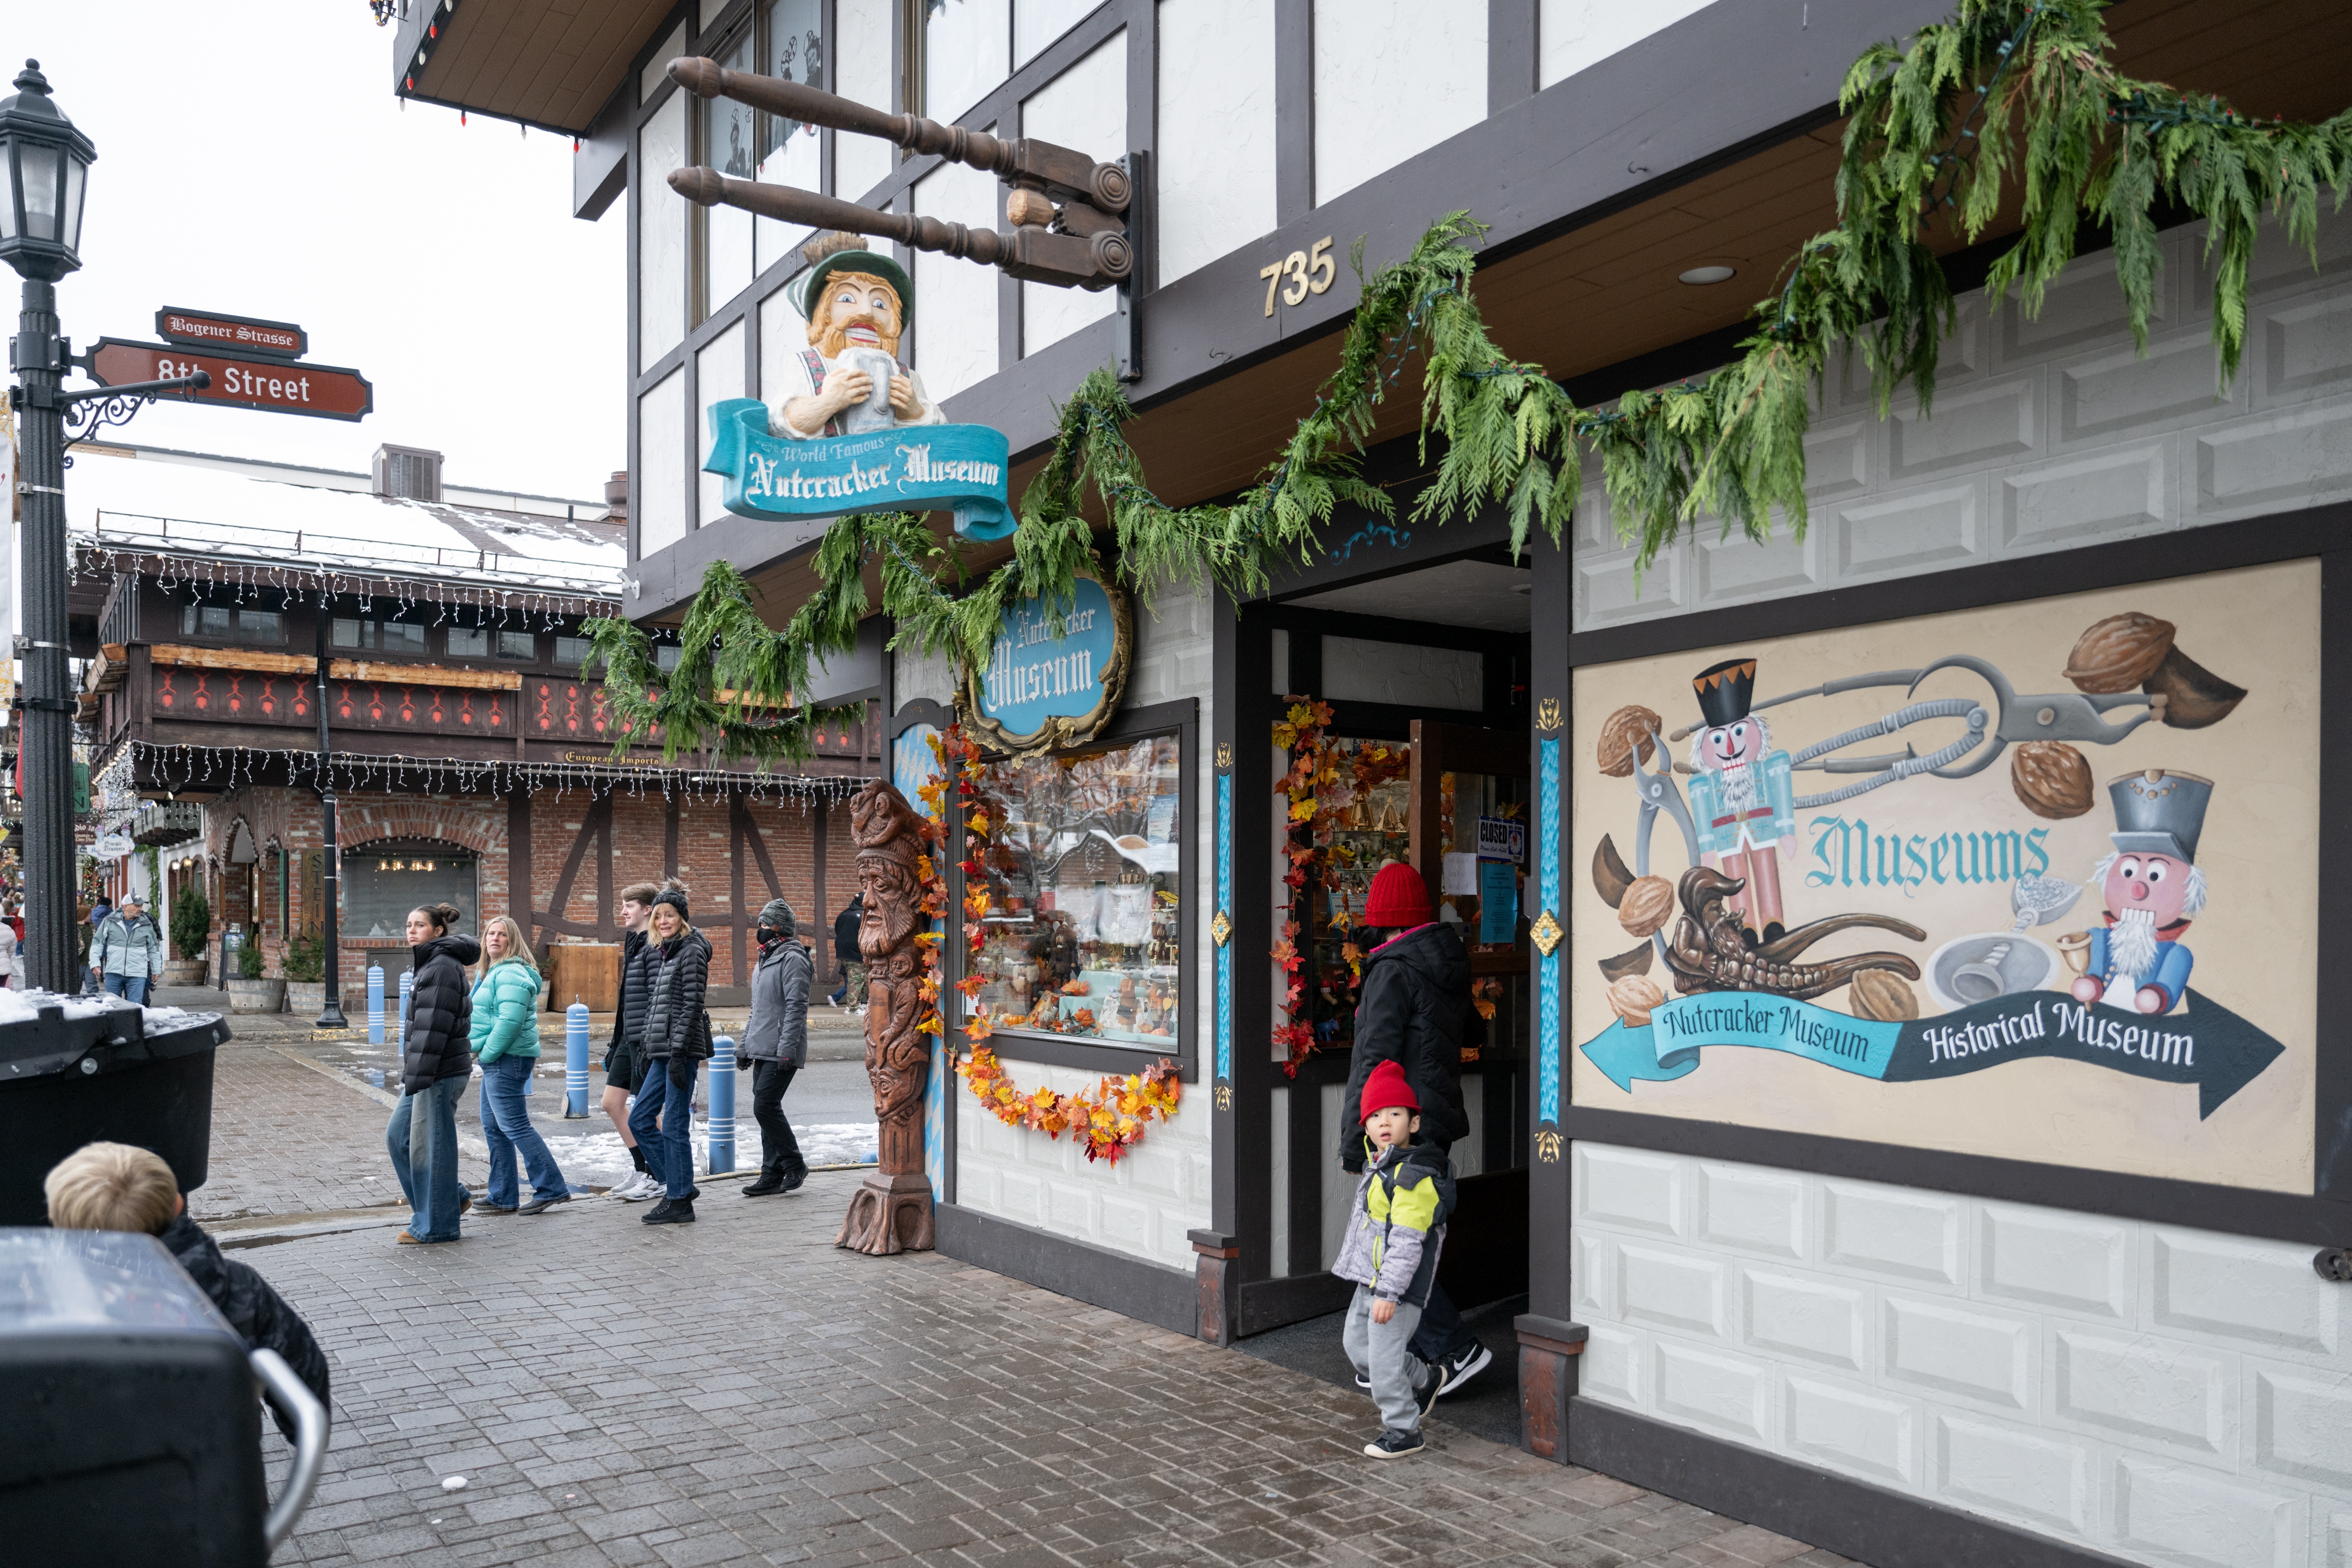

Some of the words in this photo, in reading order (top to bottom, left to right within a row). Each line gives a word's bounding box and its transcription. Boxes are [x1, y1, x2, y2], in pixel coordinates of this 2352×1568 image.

[1260, 235, 1337, 317] 735
[169, 317, 232, 337] Bogener
[236, 327, 293, 346] Strasse
[225, 367, 310, 402] Street
[745, 452, 891, 506] Nutcracker
[895, 442, 1000, 494] Museum
[781, 447, 827, 463] World
[830, 439, 886, 460] Famous
[985, 635, 1093, 713] Museum
[565, 751, 614, 764] European
[620, 755, 659, 765] Imports
[1481, 822, 1507, 844] CLOSED
[1805, 814, 2050, 898] Museums
[310, 854, 323, 934] STEIN
[1663, 999, 1775, 1038] Nutcracker
[1779, 1006, 1869, 1062] Museum
[1923, 1000, 2046, 1064] Historical
[2052, 1002, 2194, 1066] Museum
